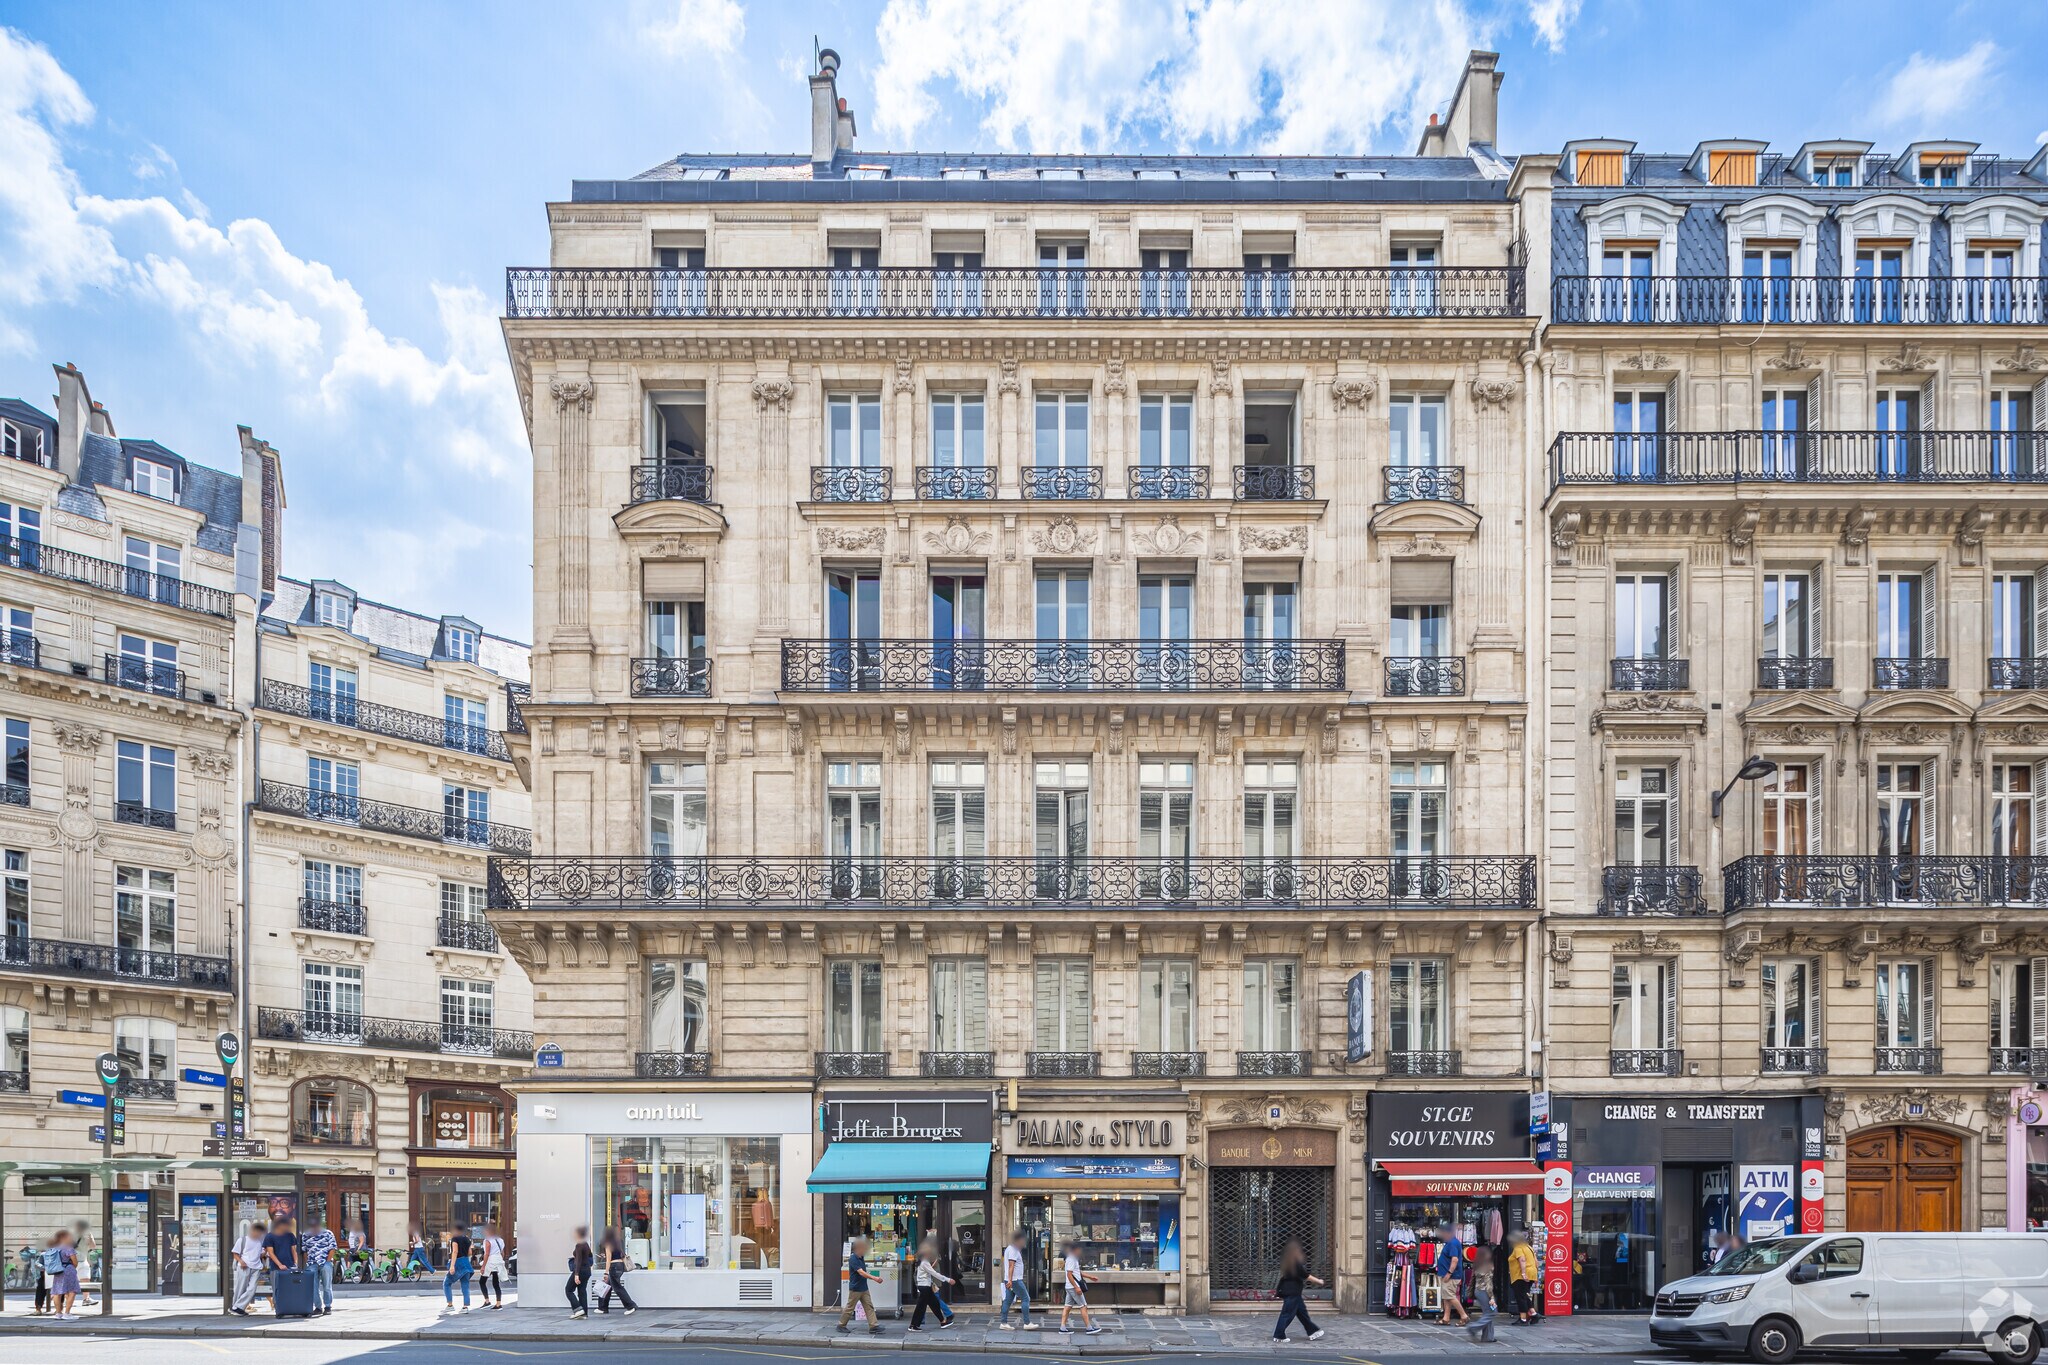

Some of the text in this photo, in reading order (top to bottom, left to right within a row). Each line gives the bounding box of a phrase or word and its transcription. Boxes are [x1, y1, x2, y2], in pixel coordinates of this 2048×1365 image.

[222, 1039, 237, 1051] BUS
[1348, 1034, 1363, 1050] BANQUE
[102, 1059, 118, 1072] BUS
[198, 1074, 214, 1082] Auber
[626, 1106, 664, 1120] ann
[1273, 1109, 1278, 1118] 9
[1421, 1106, 1474, 1122] ST.GE
[1604, 1105, 1765, 1120] CHANGE & TRANSFERT
[1913, 1105, 1920, 1113] 11
[832, 1116, 962, 1142] Jeff de Bruges
[1017, 1119, 1173, 1147] PALAIS du STYLO
[1389, 1130, 1495, 1146] SOUVENIRS
[1221, 1148, 1313, 1158] BANQUE MISR
[1588, 1172, 1641, 1183] CHANGE
[1704, 1173, 1728, 1188] ATM
[1744, 1171, 1788, 1188] ATM
[1426, 1182, 1510, 1192] SOUVENIRS DE PARIS
